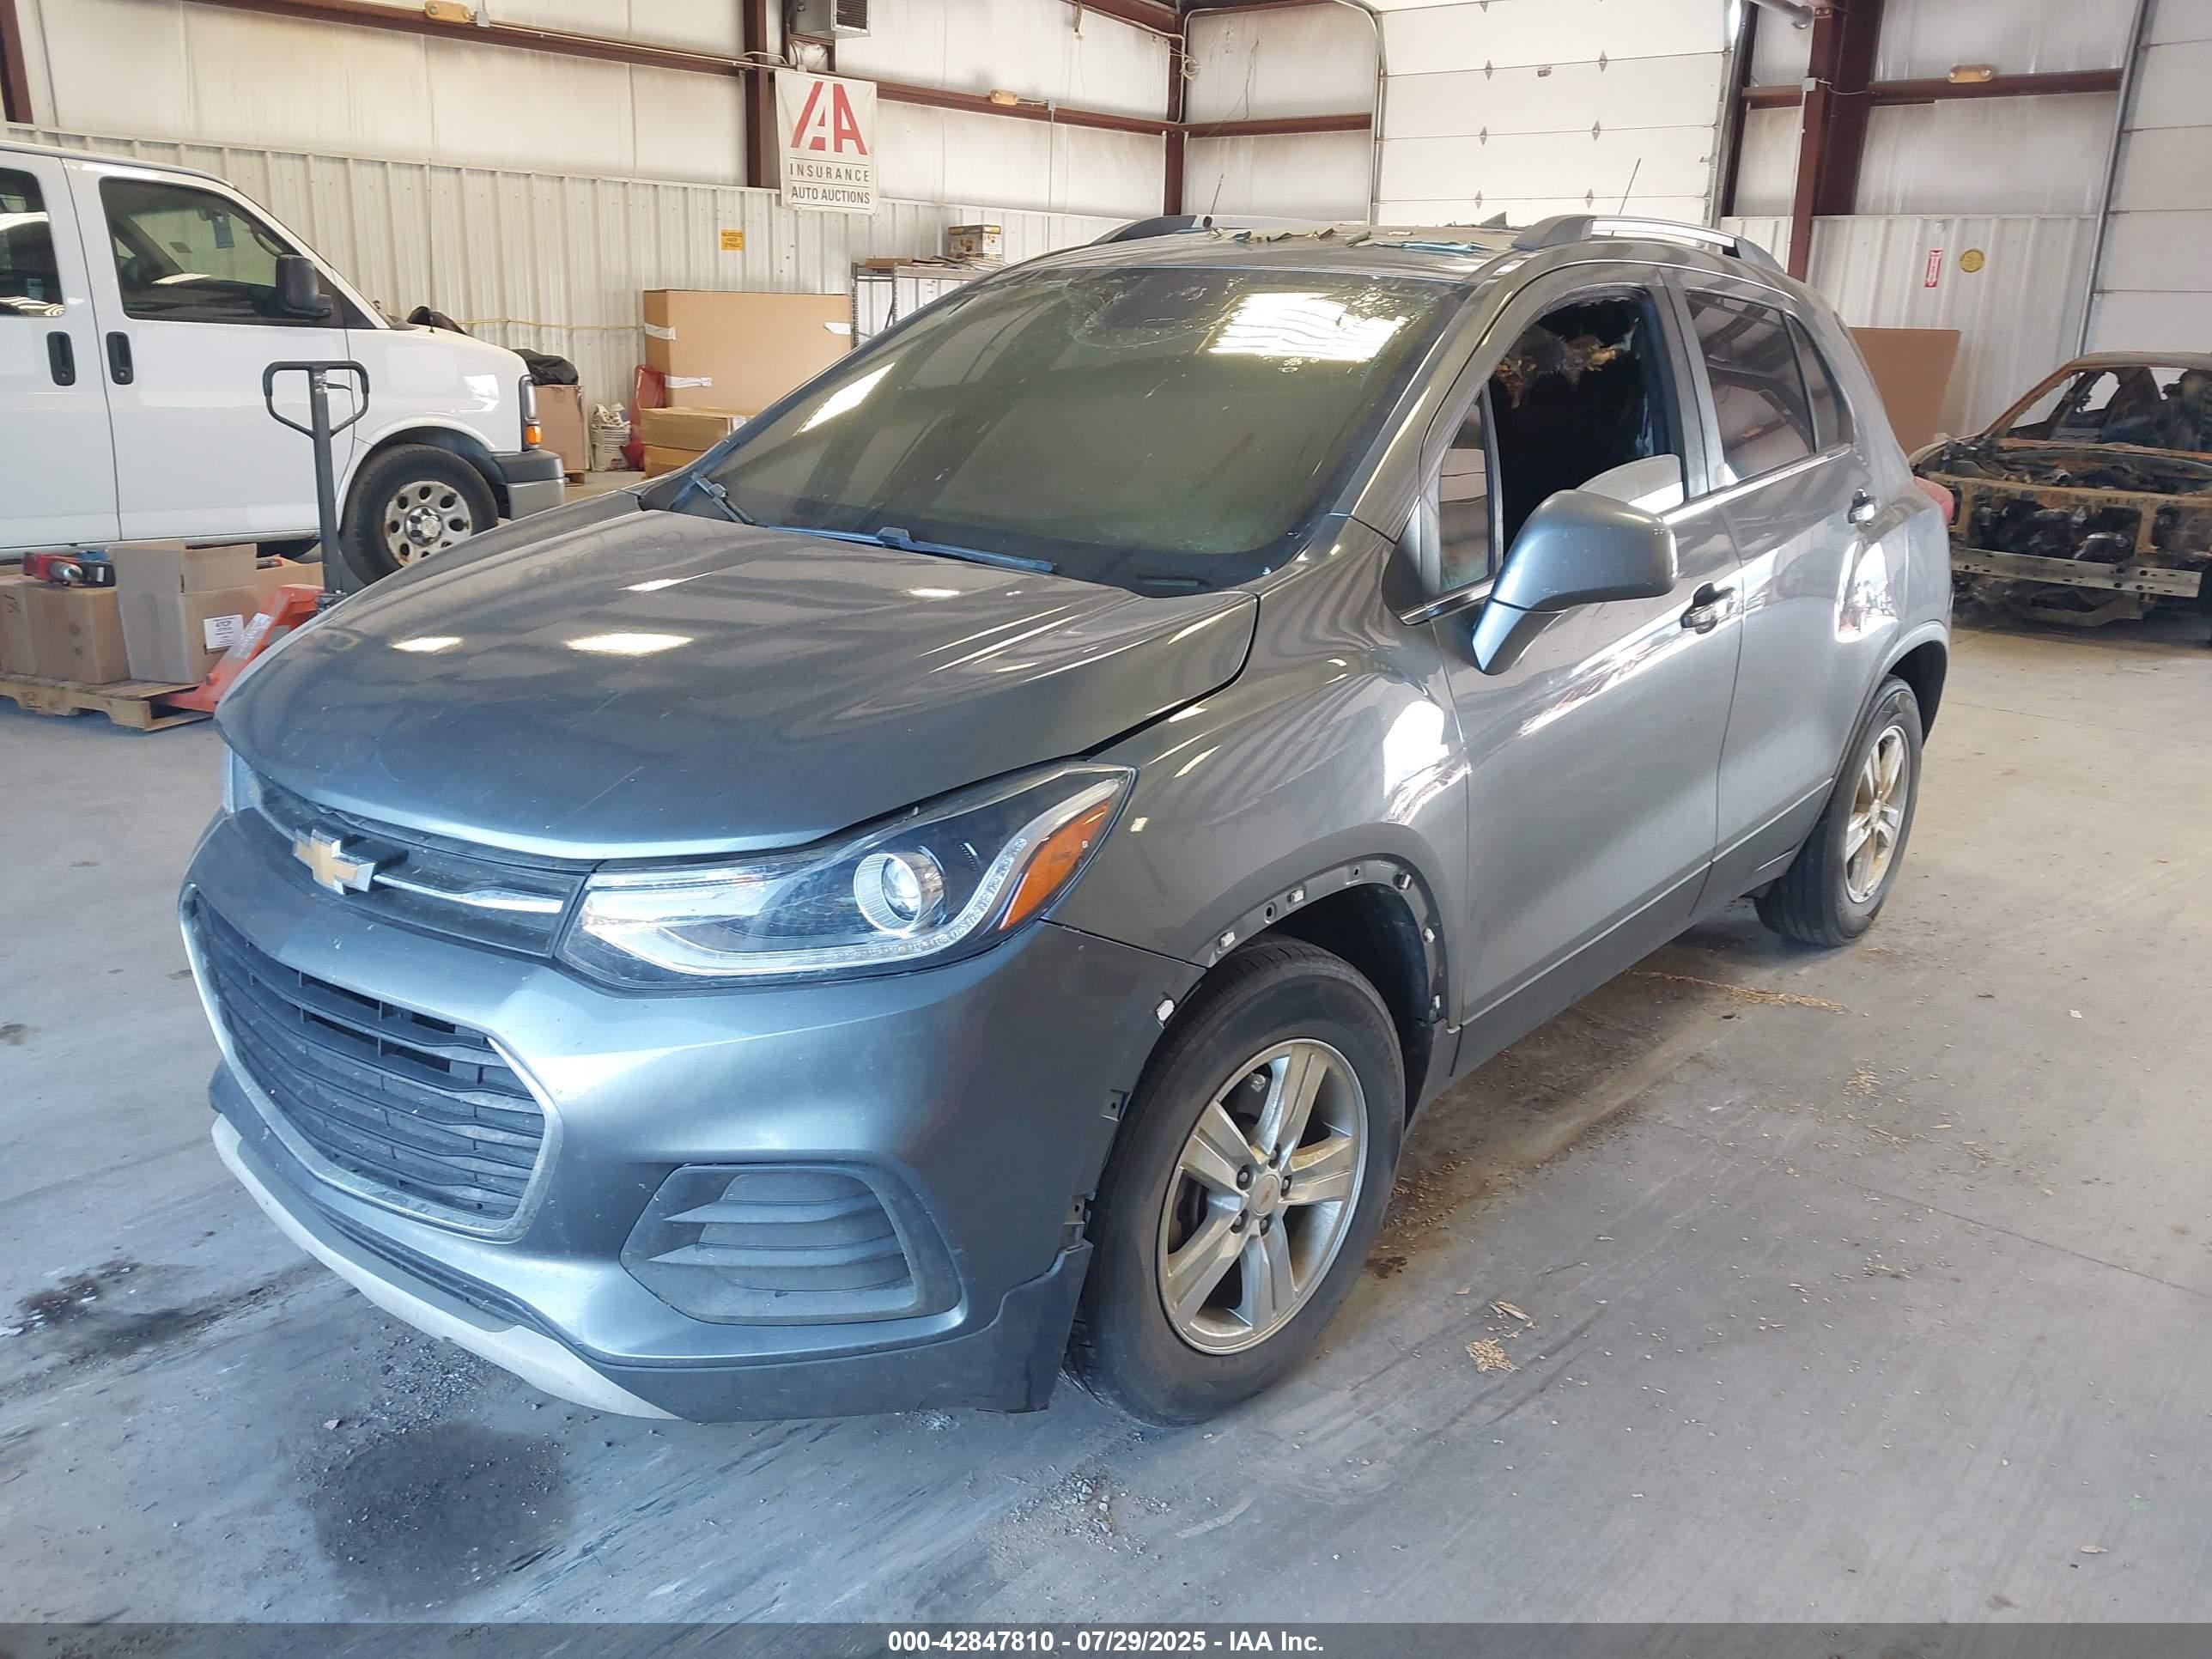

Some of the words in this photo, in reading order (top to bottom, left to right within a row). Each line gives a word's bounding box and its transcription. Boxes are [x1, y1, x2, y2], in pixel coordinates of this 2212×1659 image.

[789, 162, 870, 183] INSURANCE
[791, 185, 818, 200] AUTO
[821, 188, 871, 204] AUCTIONS
